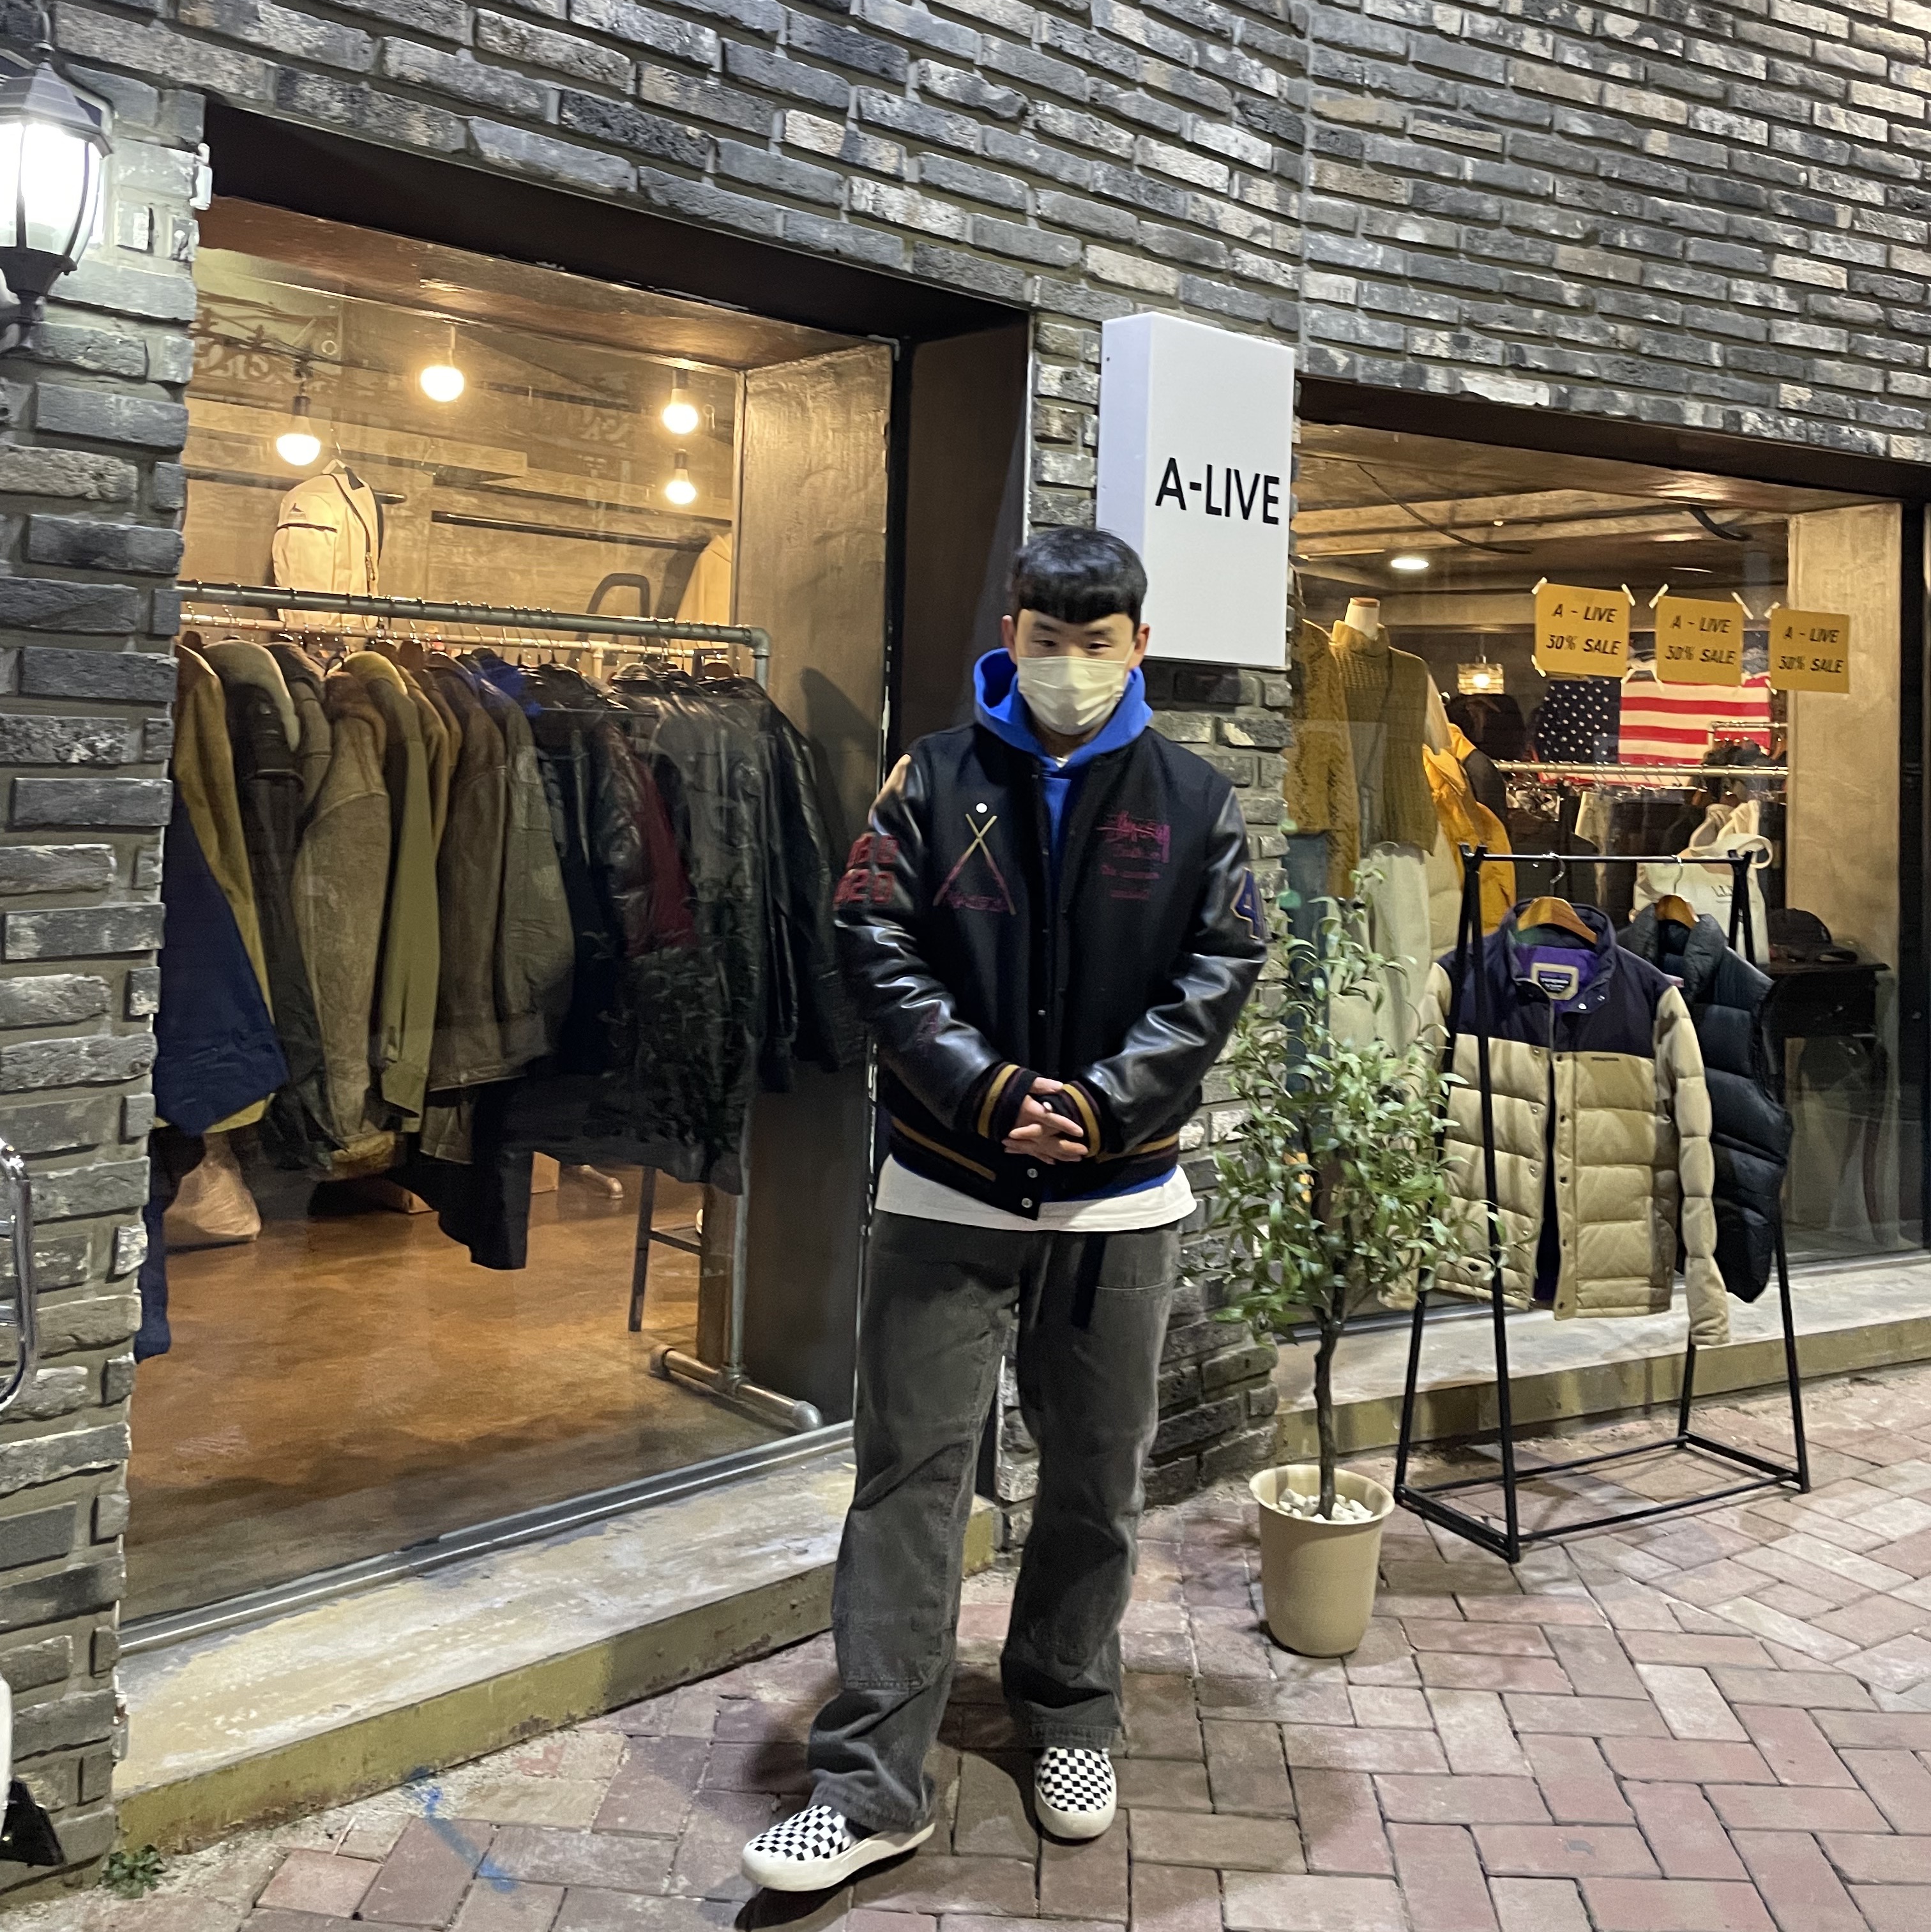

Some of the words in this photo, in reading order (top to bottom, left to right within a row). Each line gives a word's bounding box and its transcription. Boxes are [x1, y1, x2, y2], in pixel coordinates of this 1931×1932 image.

[1155, 457, 1280, 525] A-LIVE
[1551, 604, 1563, 618] A
[1584, 606, 1617, 623] LIVE
[1670, 615, 1681, 629] A
[1699, 617, 1732, 633] LIVE
[1810, 628, 1840, 643] LIVE
[1583, 639, 1621, 655] SALE
[1699, 649, 1736, 665] SALE
[1810, 658, 1844, 673] SALE
